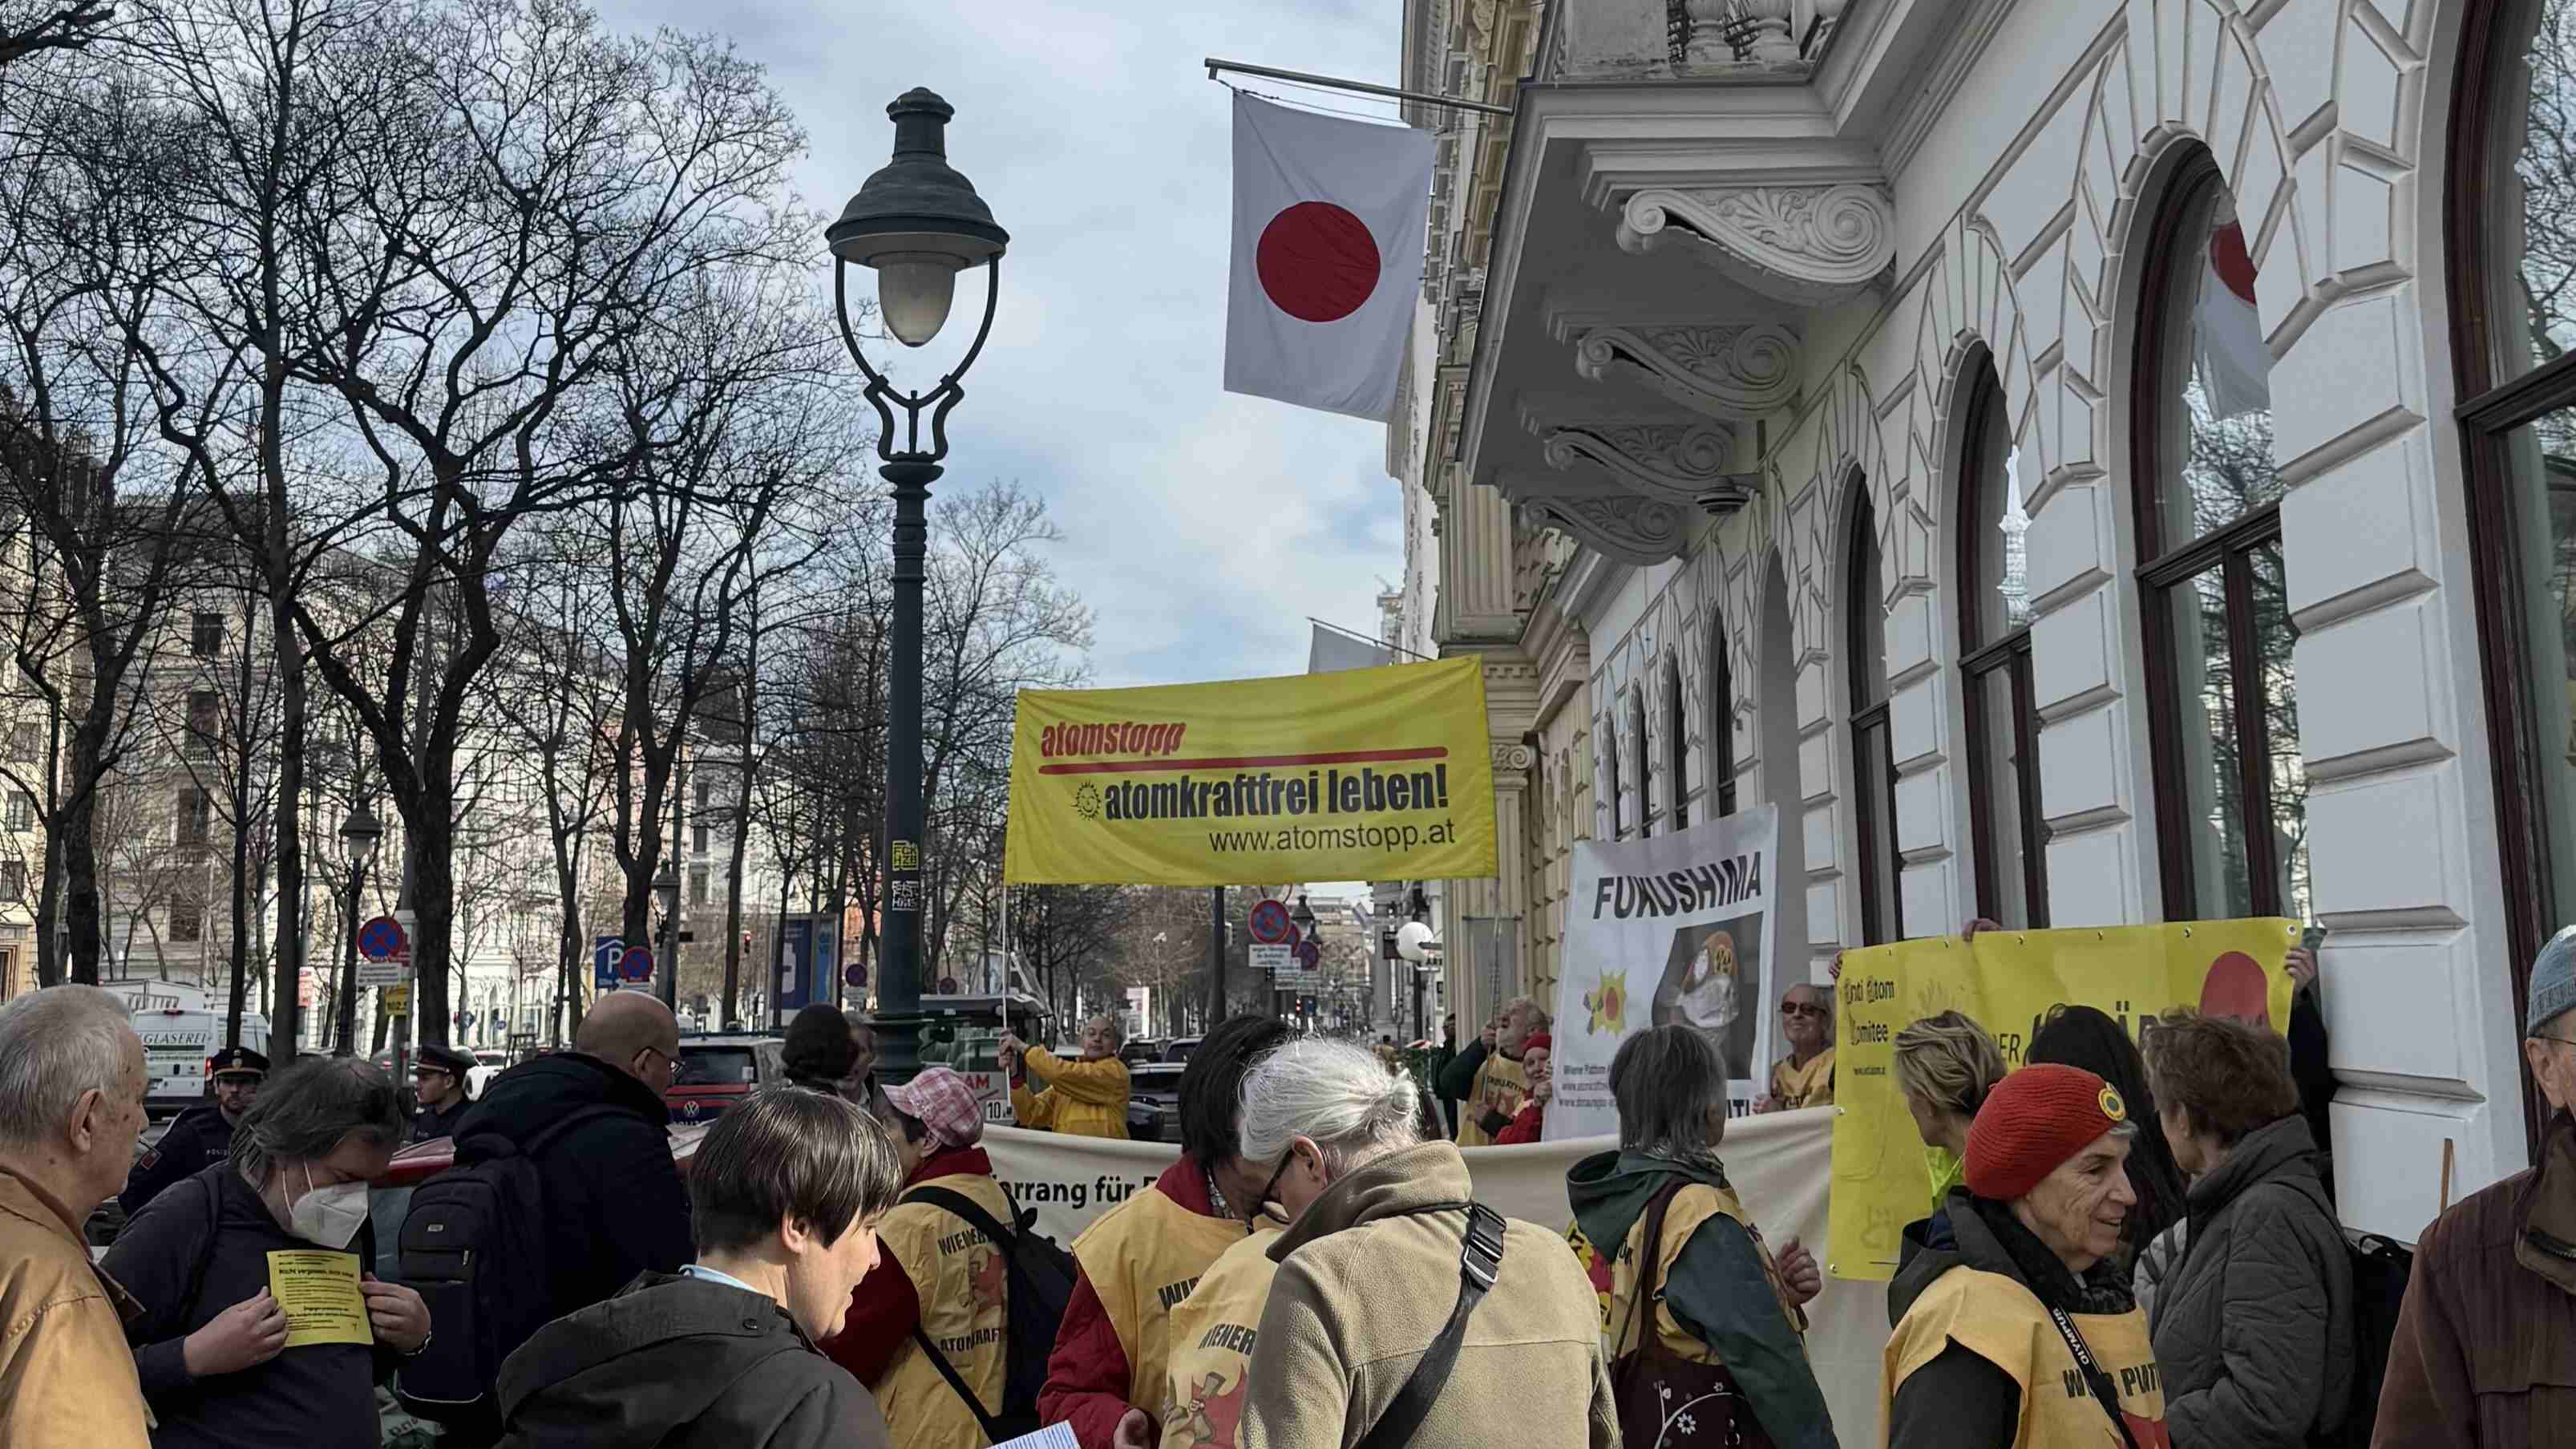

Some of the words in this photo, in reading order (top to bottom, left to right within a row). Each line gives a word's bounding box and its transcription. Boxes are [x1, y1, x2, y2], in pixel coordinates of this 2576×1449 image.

[1041, 721, 1187, 757] atomstopp
[1105, 770, 1318, 820] atomkraftfrei
[1328, 763, 1449, 813] leben!
[1209, 818, 1456, 852] www.atomstopp.at
[1592, 852, 1761, 919] FUKUSHIMA
[608, 948, 624, 973] P
[988, 1102, 1001, 1119] 10
[1095, 1176, 1135, 1202] für
[2052, 1308, 2089, 1365] OLYMPUS
